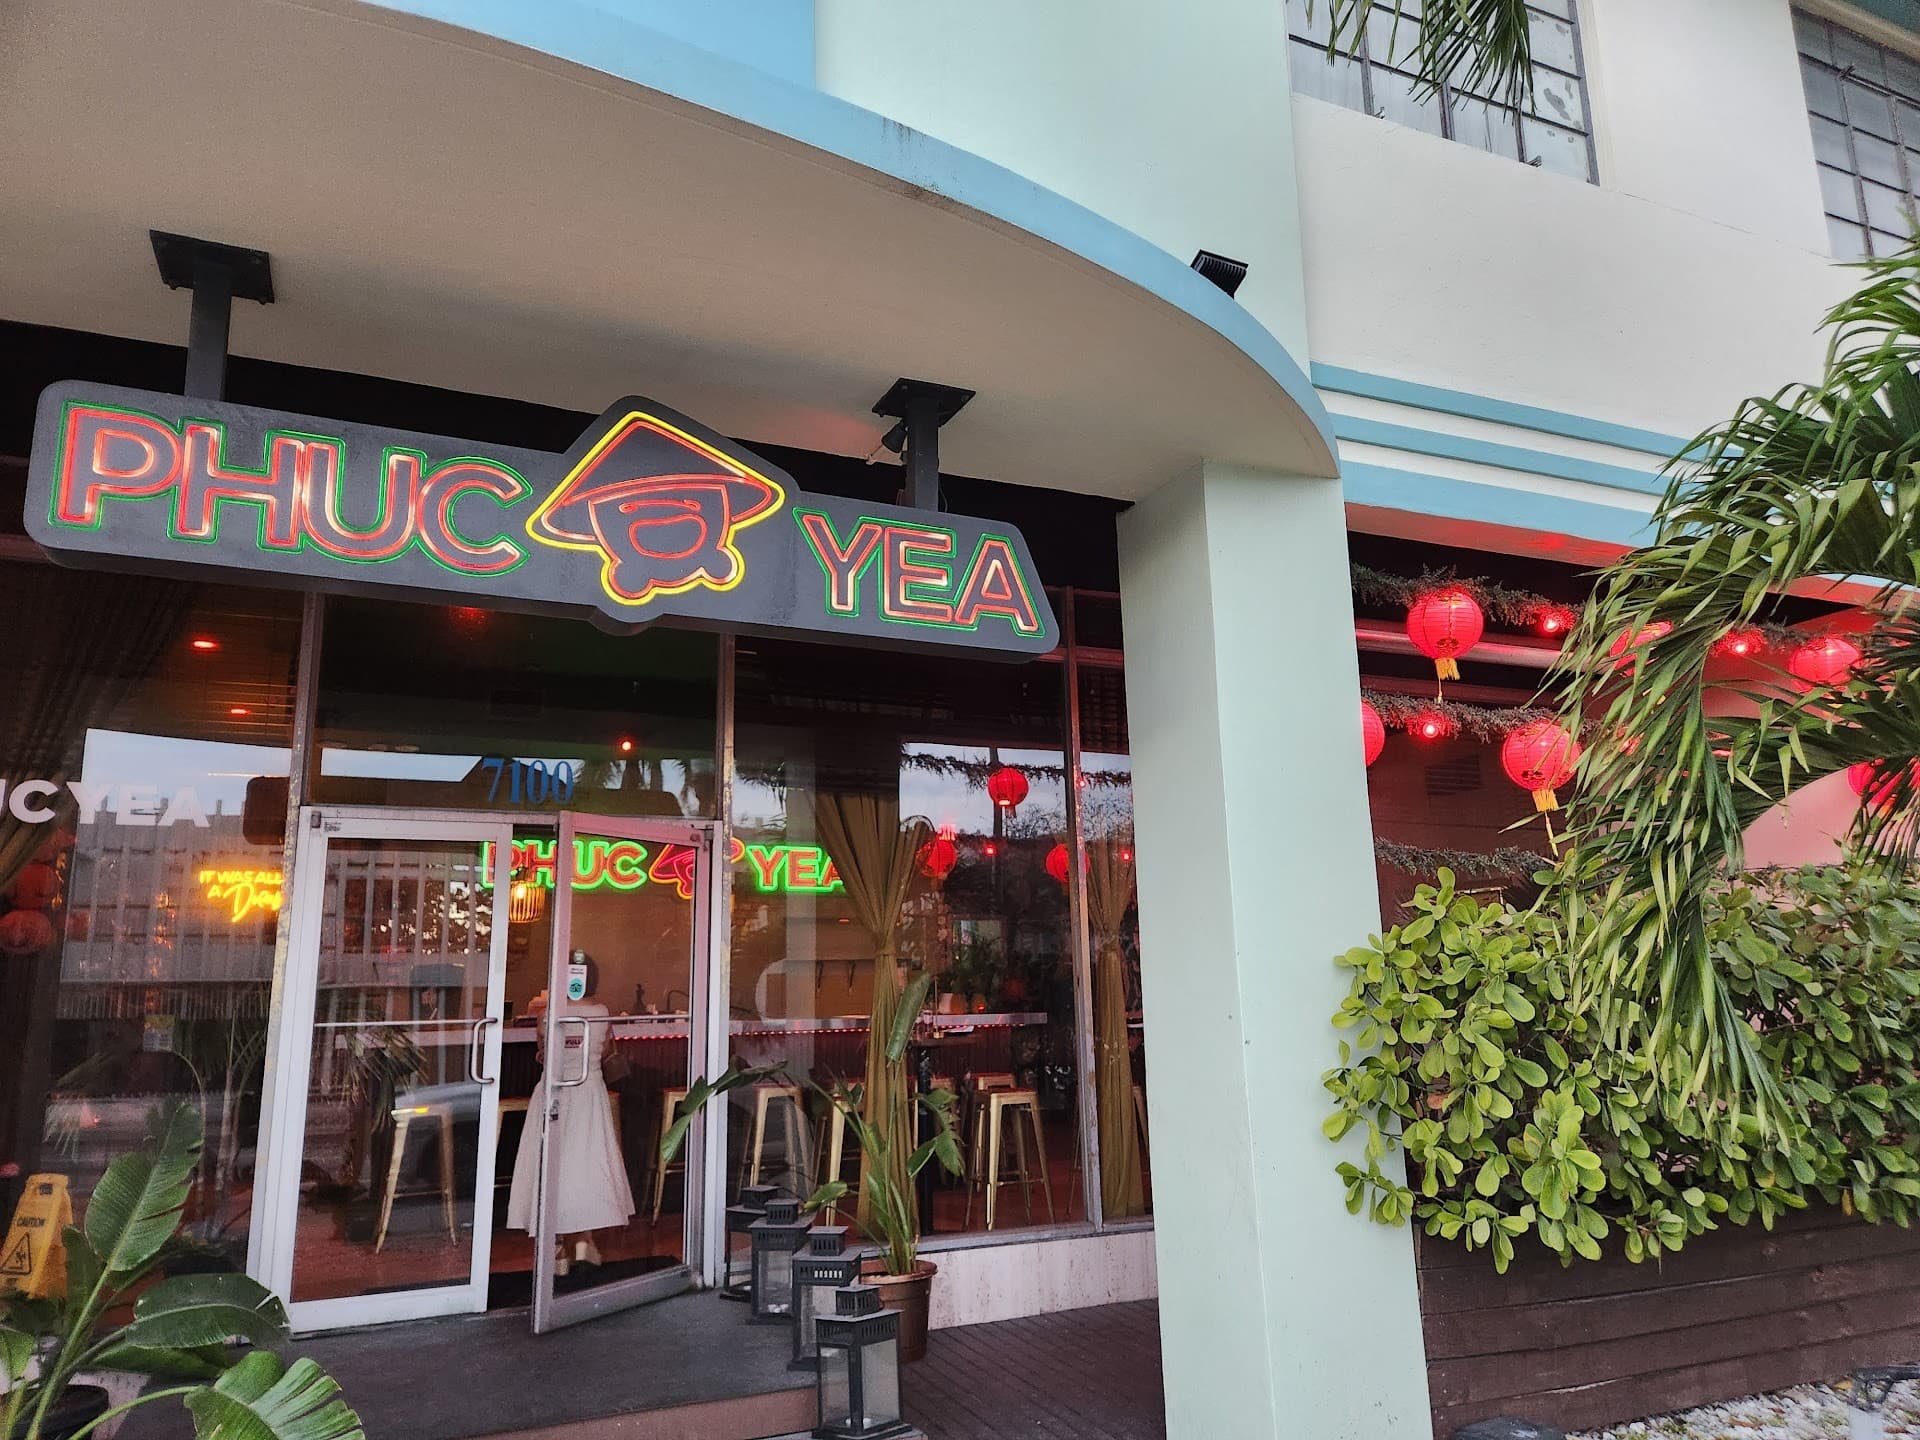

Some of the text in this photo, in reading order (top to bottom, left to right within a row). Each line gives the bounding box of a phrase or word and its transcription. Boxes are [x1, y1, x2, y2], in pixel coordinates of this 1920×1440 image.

[48, 400, 1046, 638] PHUC YEA
[482, 759, 574, 804] 7100
[67, 781, 210, 828] YEA
[199, 870, 283, 885] IT WAS ALL
[207, 884, 222, 899] A
[16, 1216, 46, 1228] CAUTION
